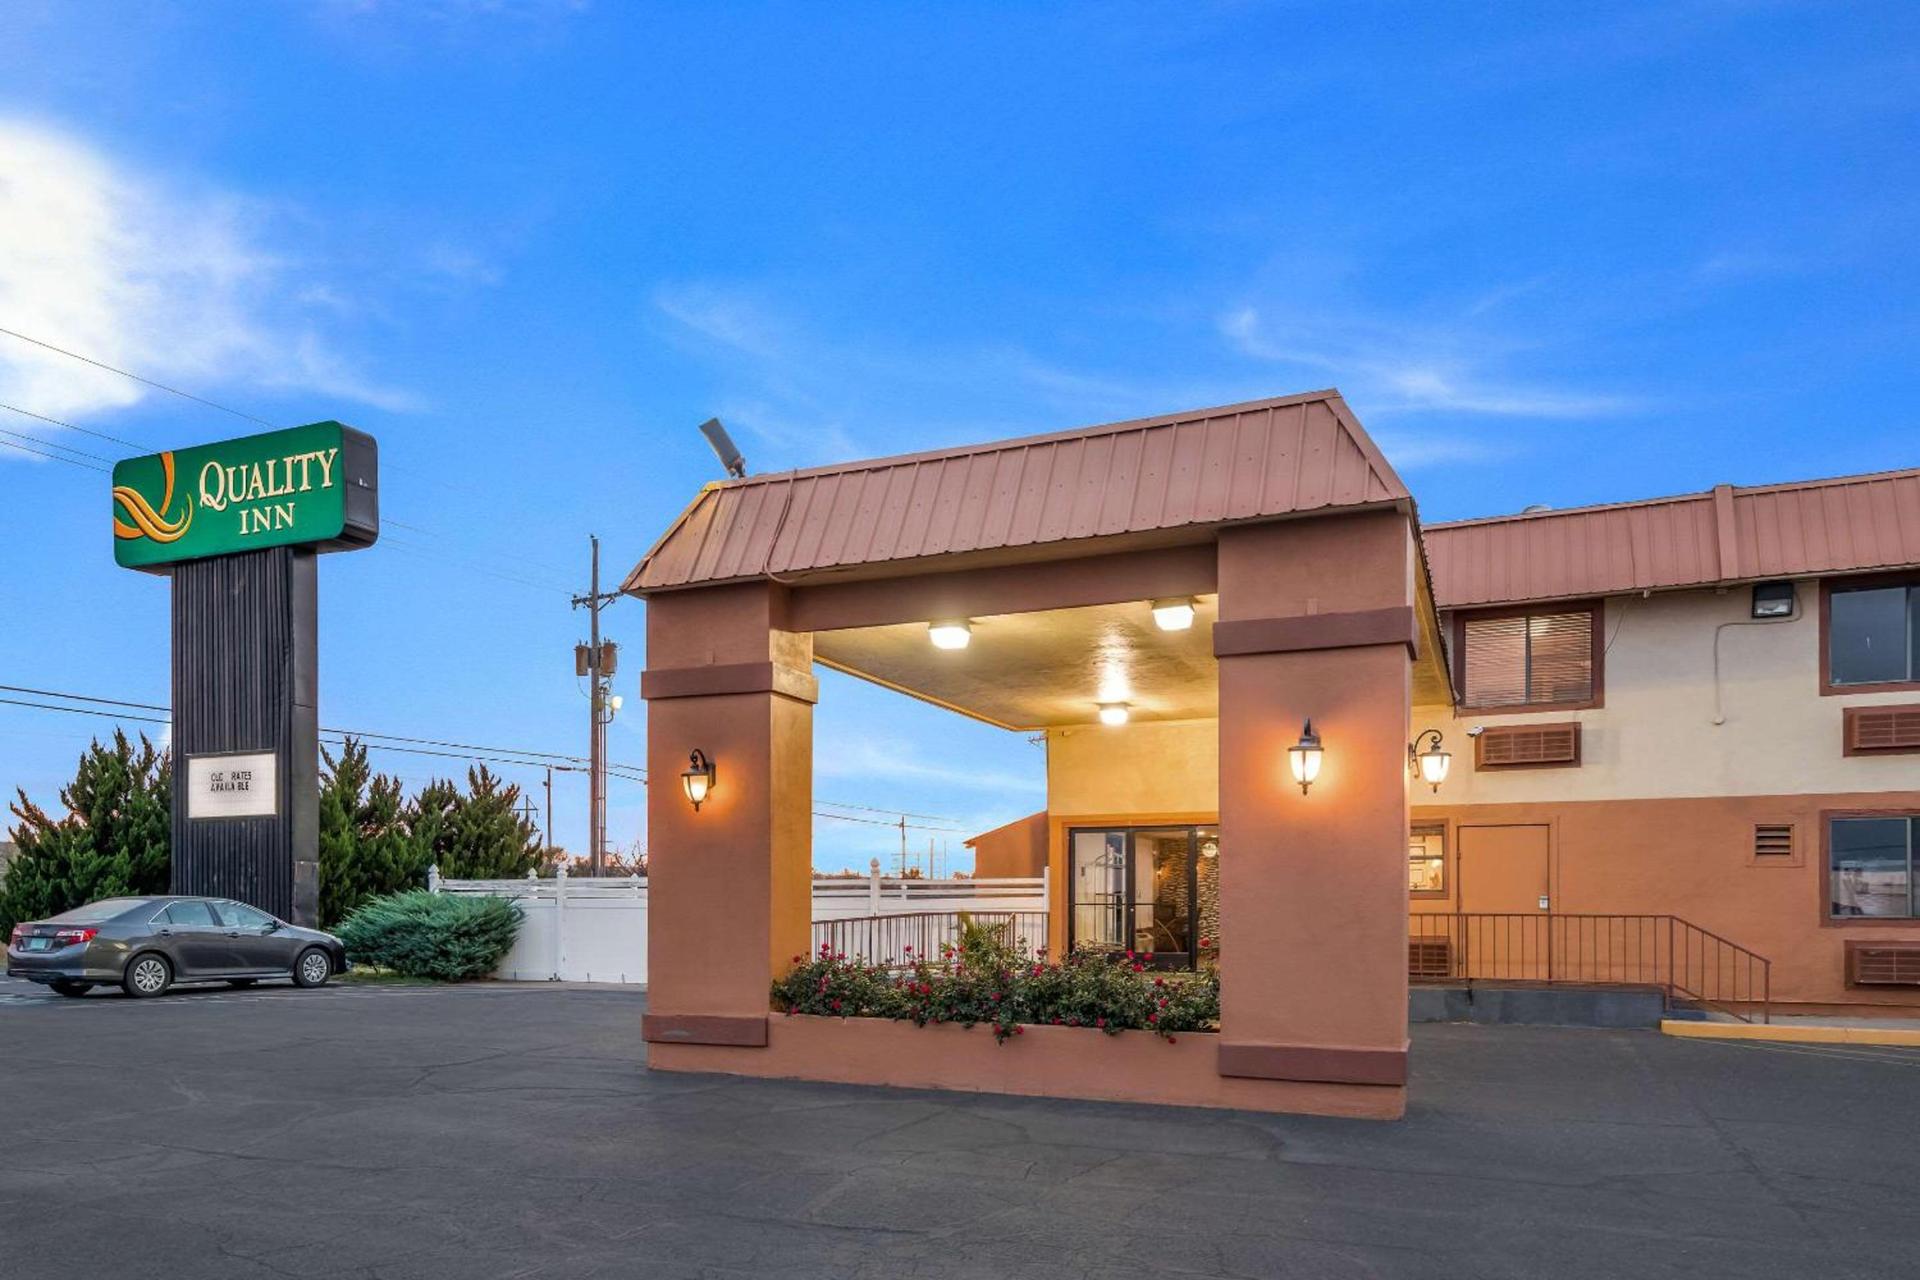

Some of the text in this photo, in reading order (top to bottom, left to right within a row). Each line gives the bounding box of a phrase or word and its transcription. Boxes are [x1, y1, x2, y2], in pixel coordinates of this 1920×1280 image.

[199, 448, 338, 511] QUALITY
[239, 502, 296, 535] INN
[231, 771, 252, 781] RATES
